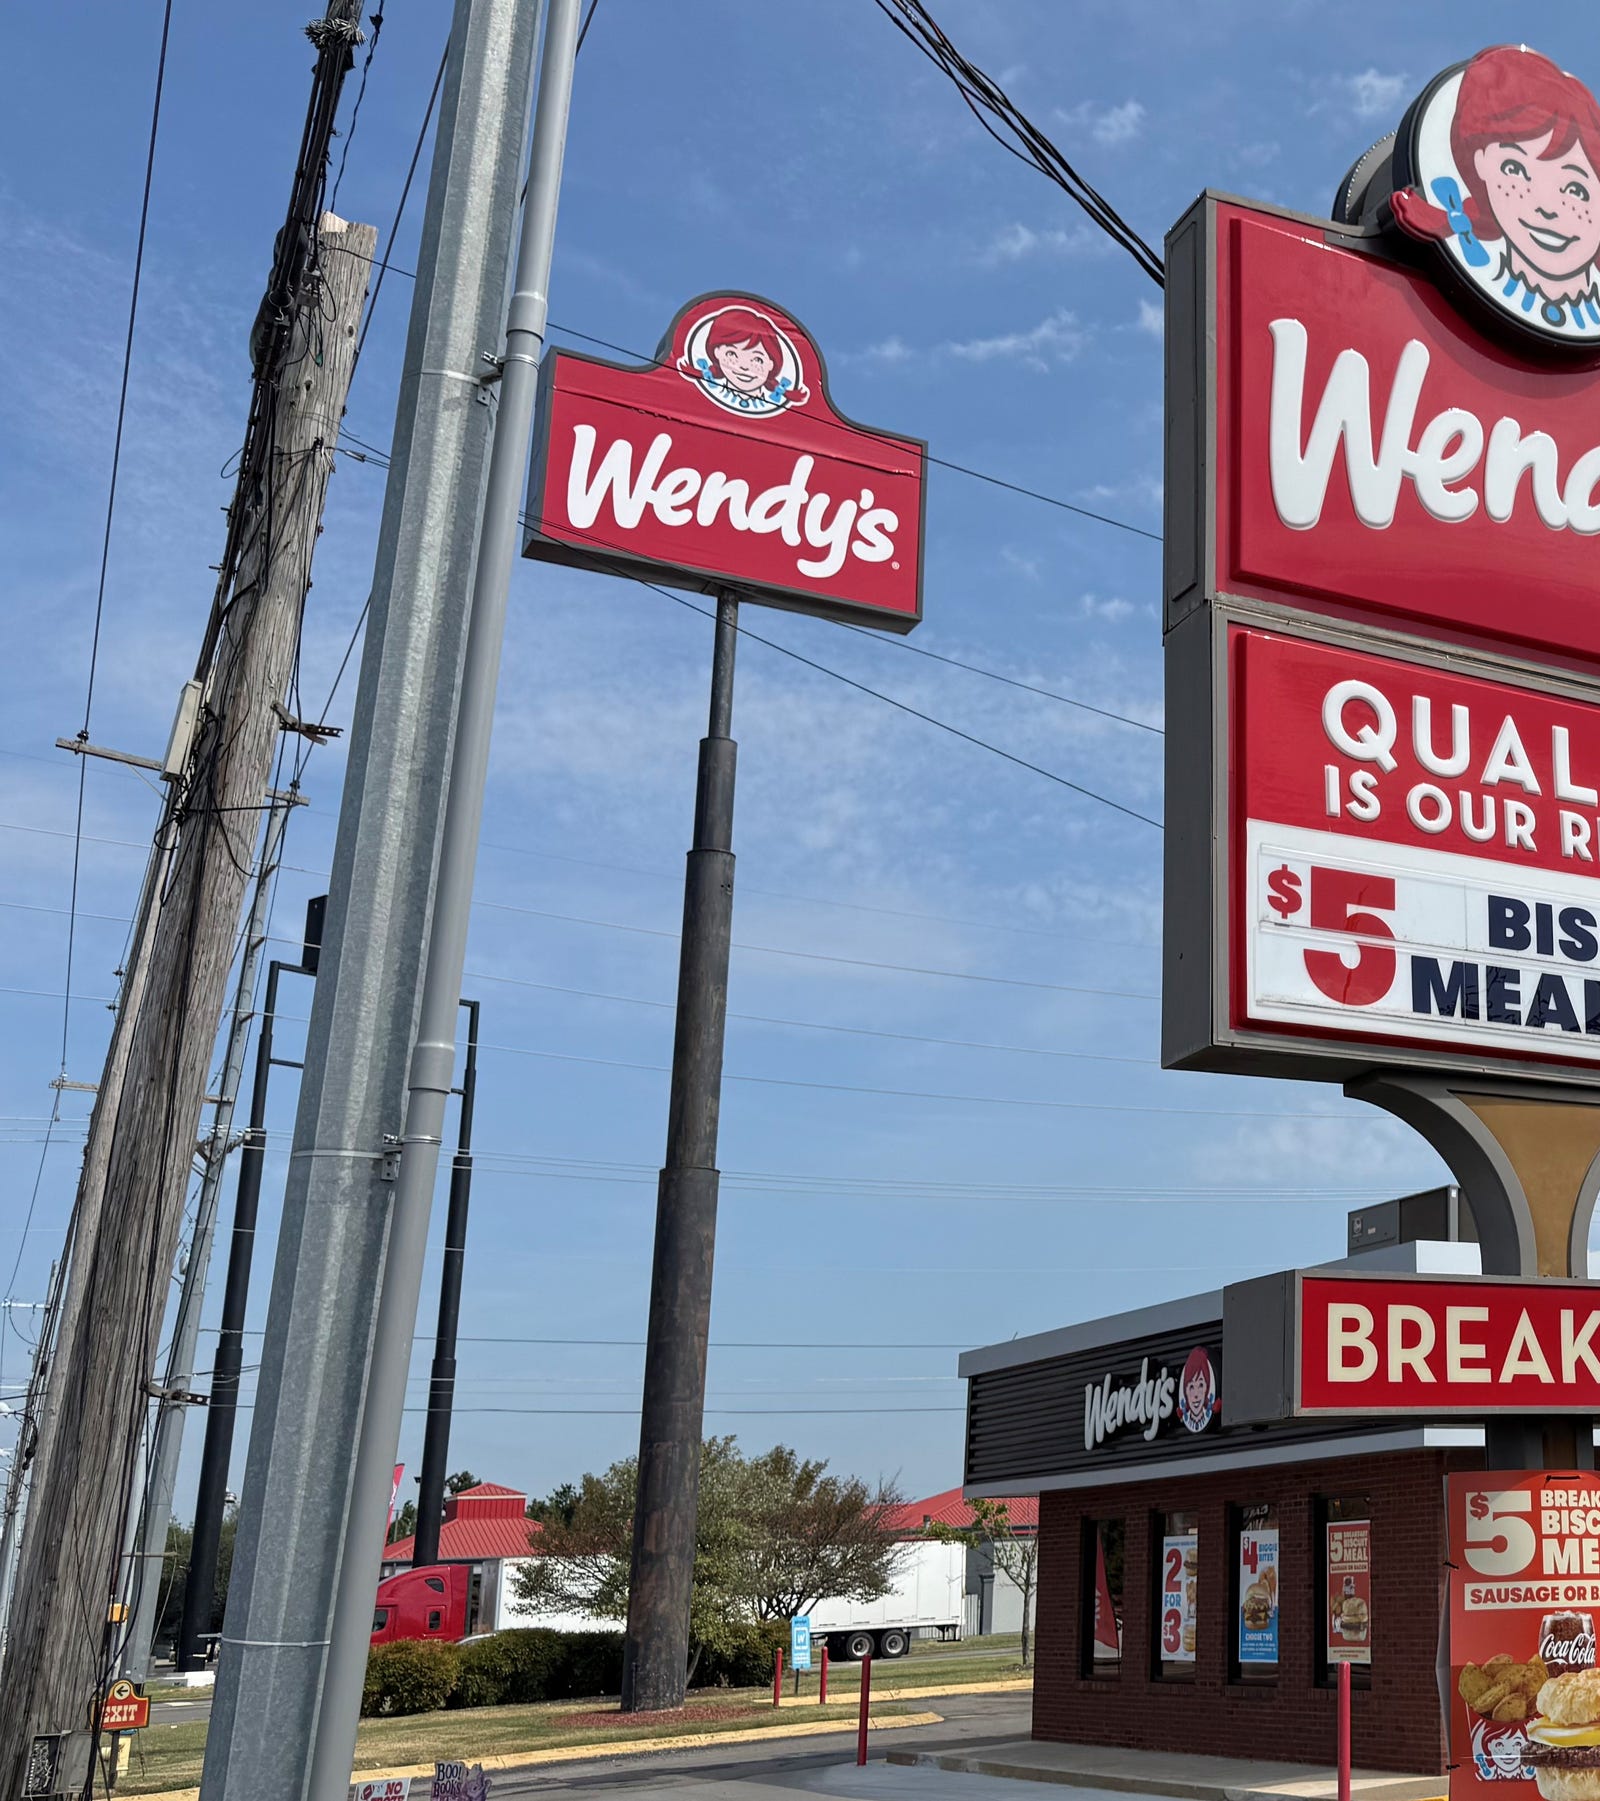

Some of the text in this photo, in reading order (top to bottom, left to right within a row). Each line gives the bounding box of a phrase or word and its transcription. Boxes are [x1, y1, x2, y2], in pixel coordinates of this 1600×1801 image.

[567, 424, 899, 579] Wendy's
[1324, 764, 1384, 823] IS
[1406, 783, 1539, 853] OUR
[1267, 863, 1398, 1007] $5
[1084, 1356, 1176, 1451] Wendy's
[1343, 1547, 1368, 1562] MEAL
[1463, 1490, 1537, 1577] $5
[1165, 1547, 1182, 1592] 2
[1164, 1593, 1182, 1608] FOR
[1470, 1587, 1560, 1605] SAUSAGE
[1563, 1585, 1587, 1602] OR
[1163, 1607, 1183, 1654] $3
[102, 1703, 139, 1724] EXIT
[384, 1781, 403, 1796] NO
[437, 1763, 462, 1782] BOO!
